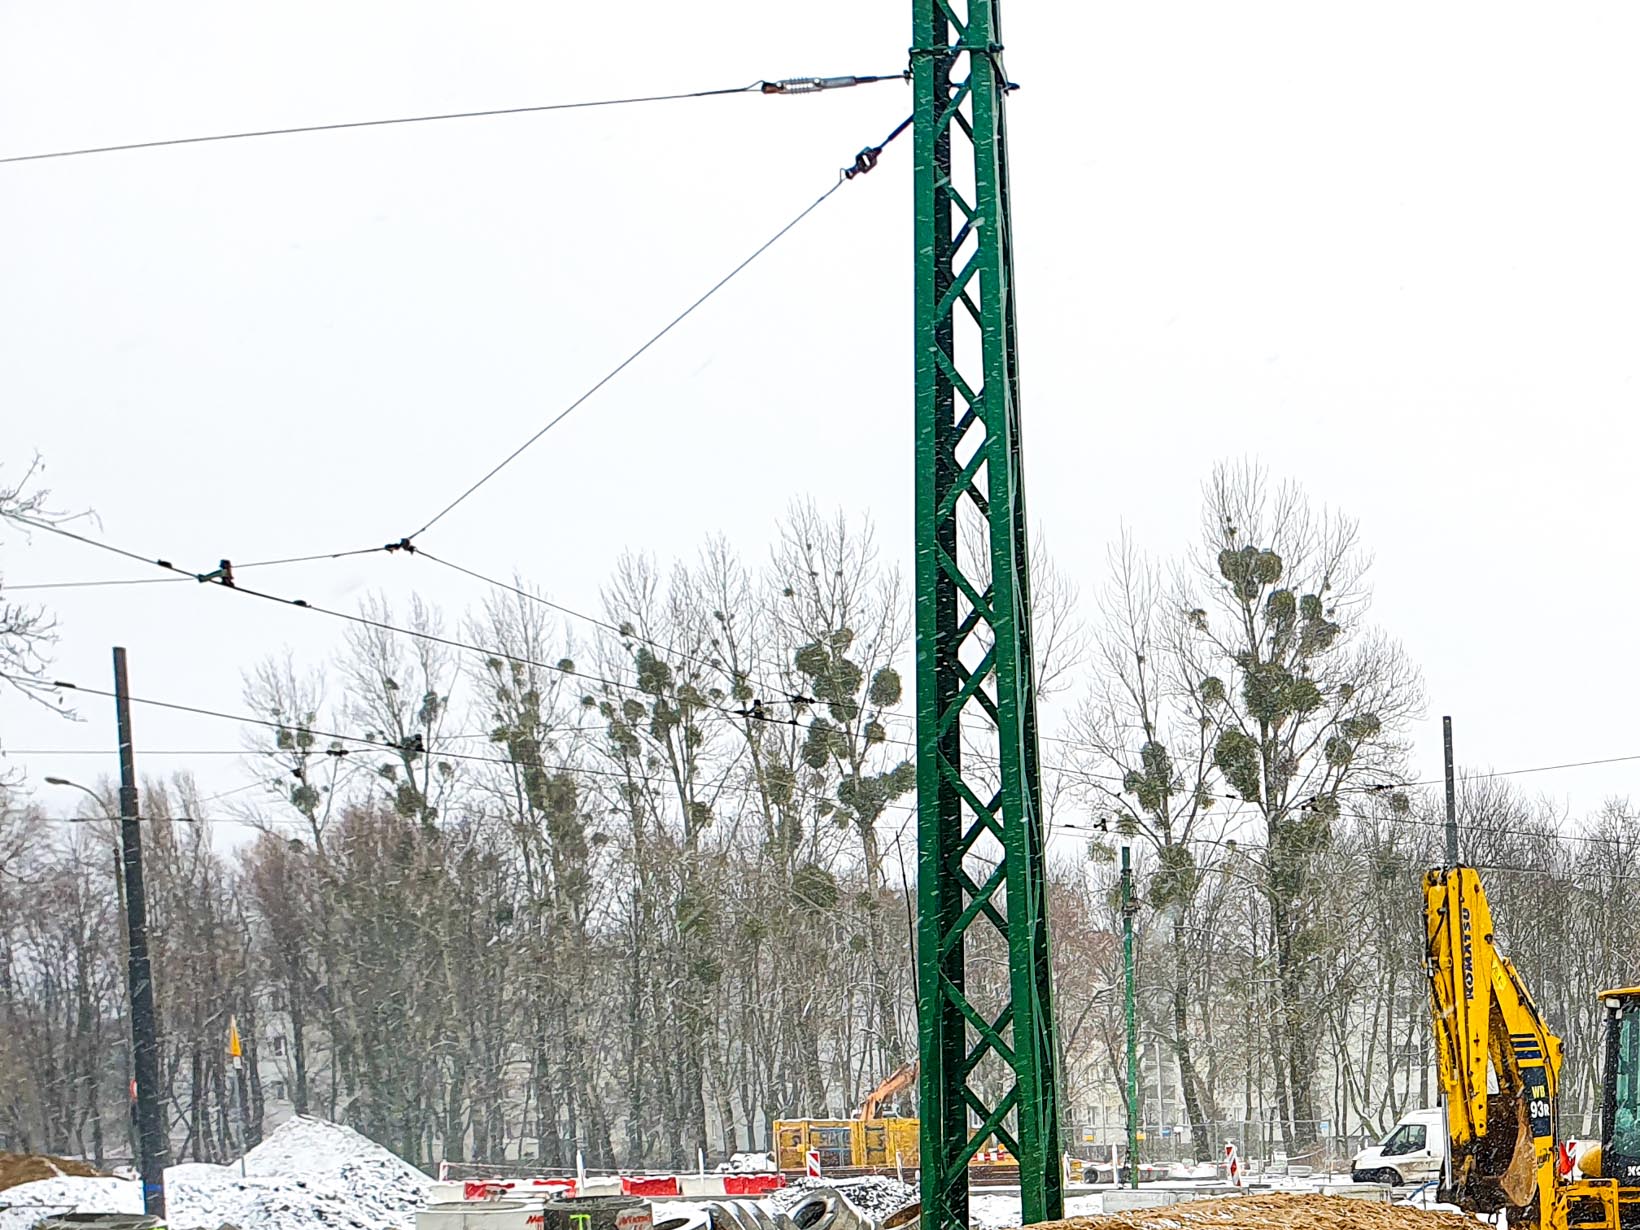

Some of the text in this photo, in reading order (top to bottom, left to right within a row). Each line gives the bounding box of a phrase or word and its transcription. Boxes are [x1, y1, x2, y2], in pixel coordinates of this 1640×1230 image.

[1462, 907, 1474, 1000] KOMATSU
[1531, 1085, 1546, 1099] WB
[1530, 1101, 1550, 1118] 93R
